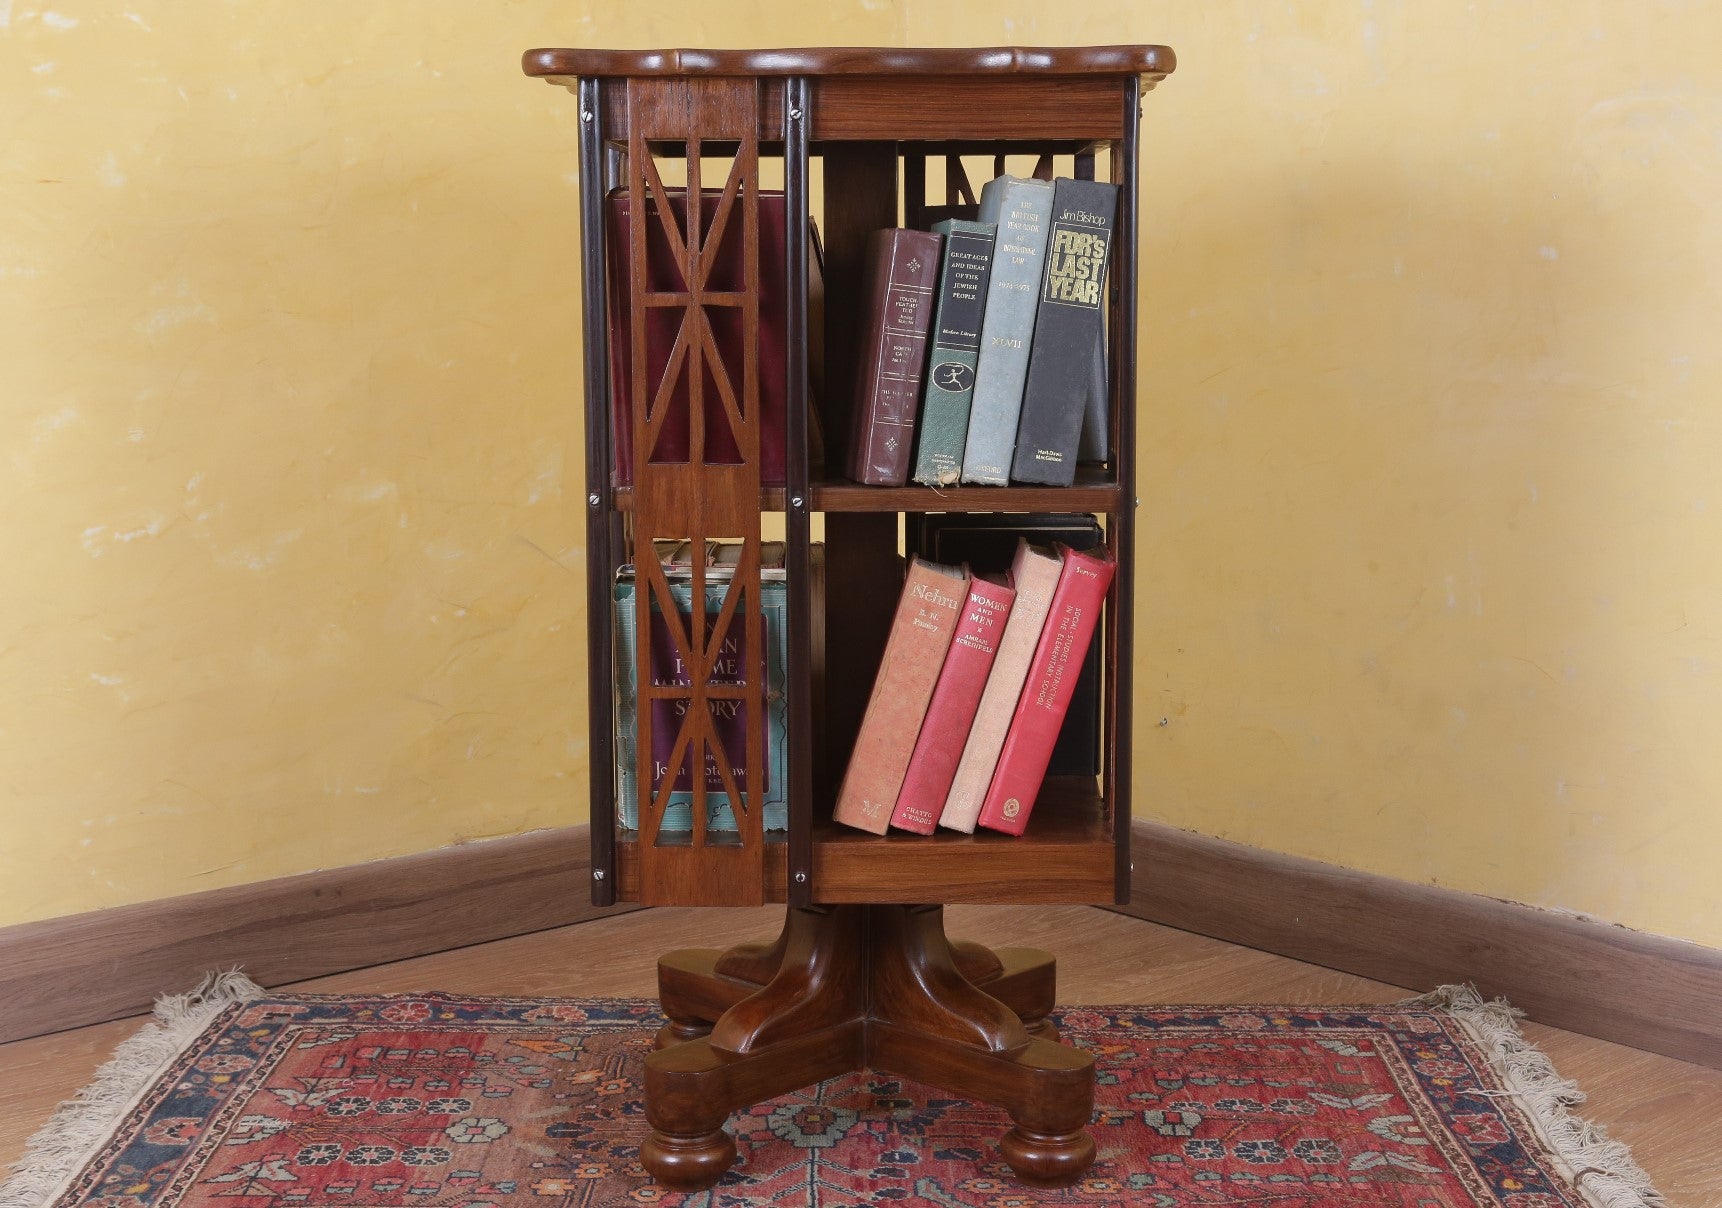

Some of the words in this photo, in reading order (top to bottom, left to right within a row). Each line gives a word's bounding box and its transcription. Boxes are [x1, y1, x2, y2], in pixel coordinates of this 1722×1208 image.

[1060, 209, 1075, 220] Jim
[1077, 210, 1106, 227] Bishop
[1053, 229, 1106, 259] FDR's
[950, 251, 971, 260] GREAT
[972, 254, 989, 262] AGES
[1051, 252, 1104, 281] LAST
[953, 282, 978, 291] JEWISH
[965, 273, 979, 281] THE
[952, 292, 976, 300] PEOPLE
[1049, 275, 1100, 305] YEAR
[992, 336, 1022, 349] XLVII
[910, 582, 959, 610] Nehru
[970, 592, 1008, 612] WOMEN
[969, 612, 994, 628] MEN
[976, 606, 994, 616] AND
[1060, 616, 1070, 631] THE
[1048, 633, 1065, 677] ELEMENTARY
[1060, 634, 1074, 664] STUDIES
[675, 700, 742, 720] SRY
[654, 761, 687, 781] Jon
